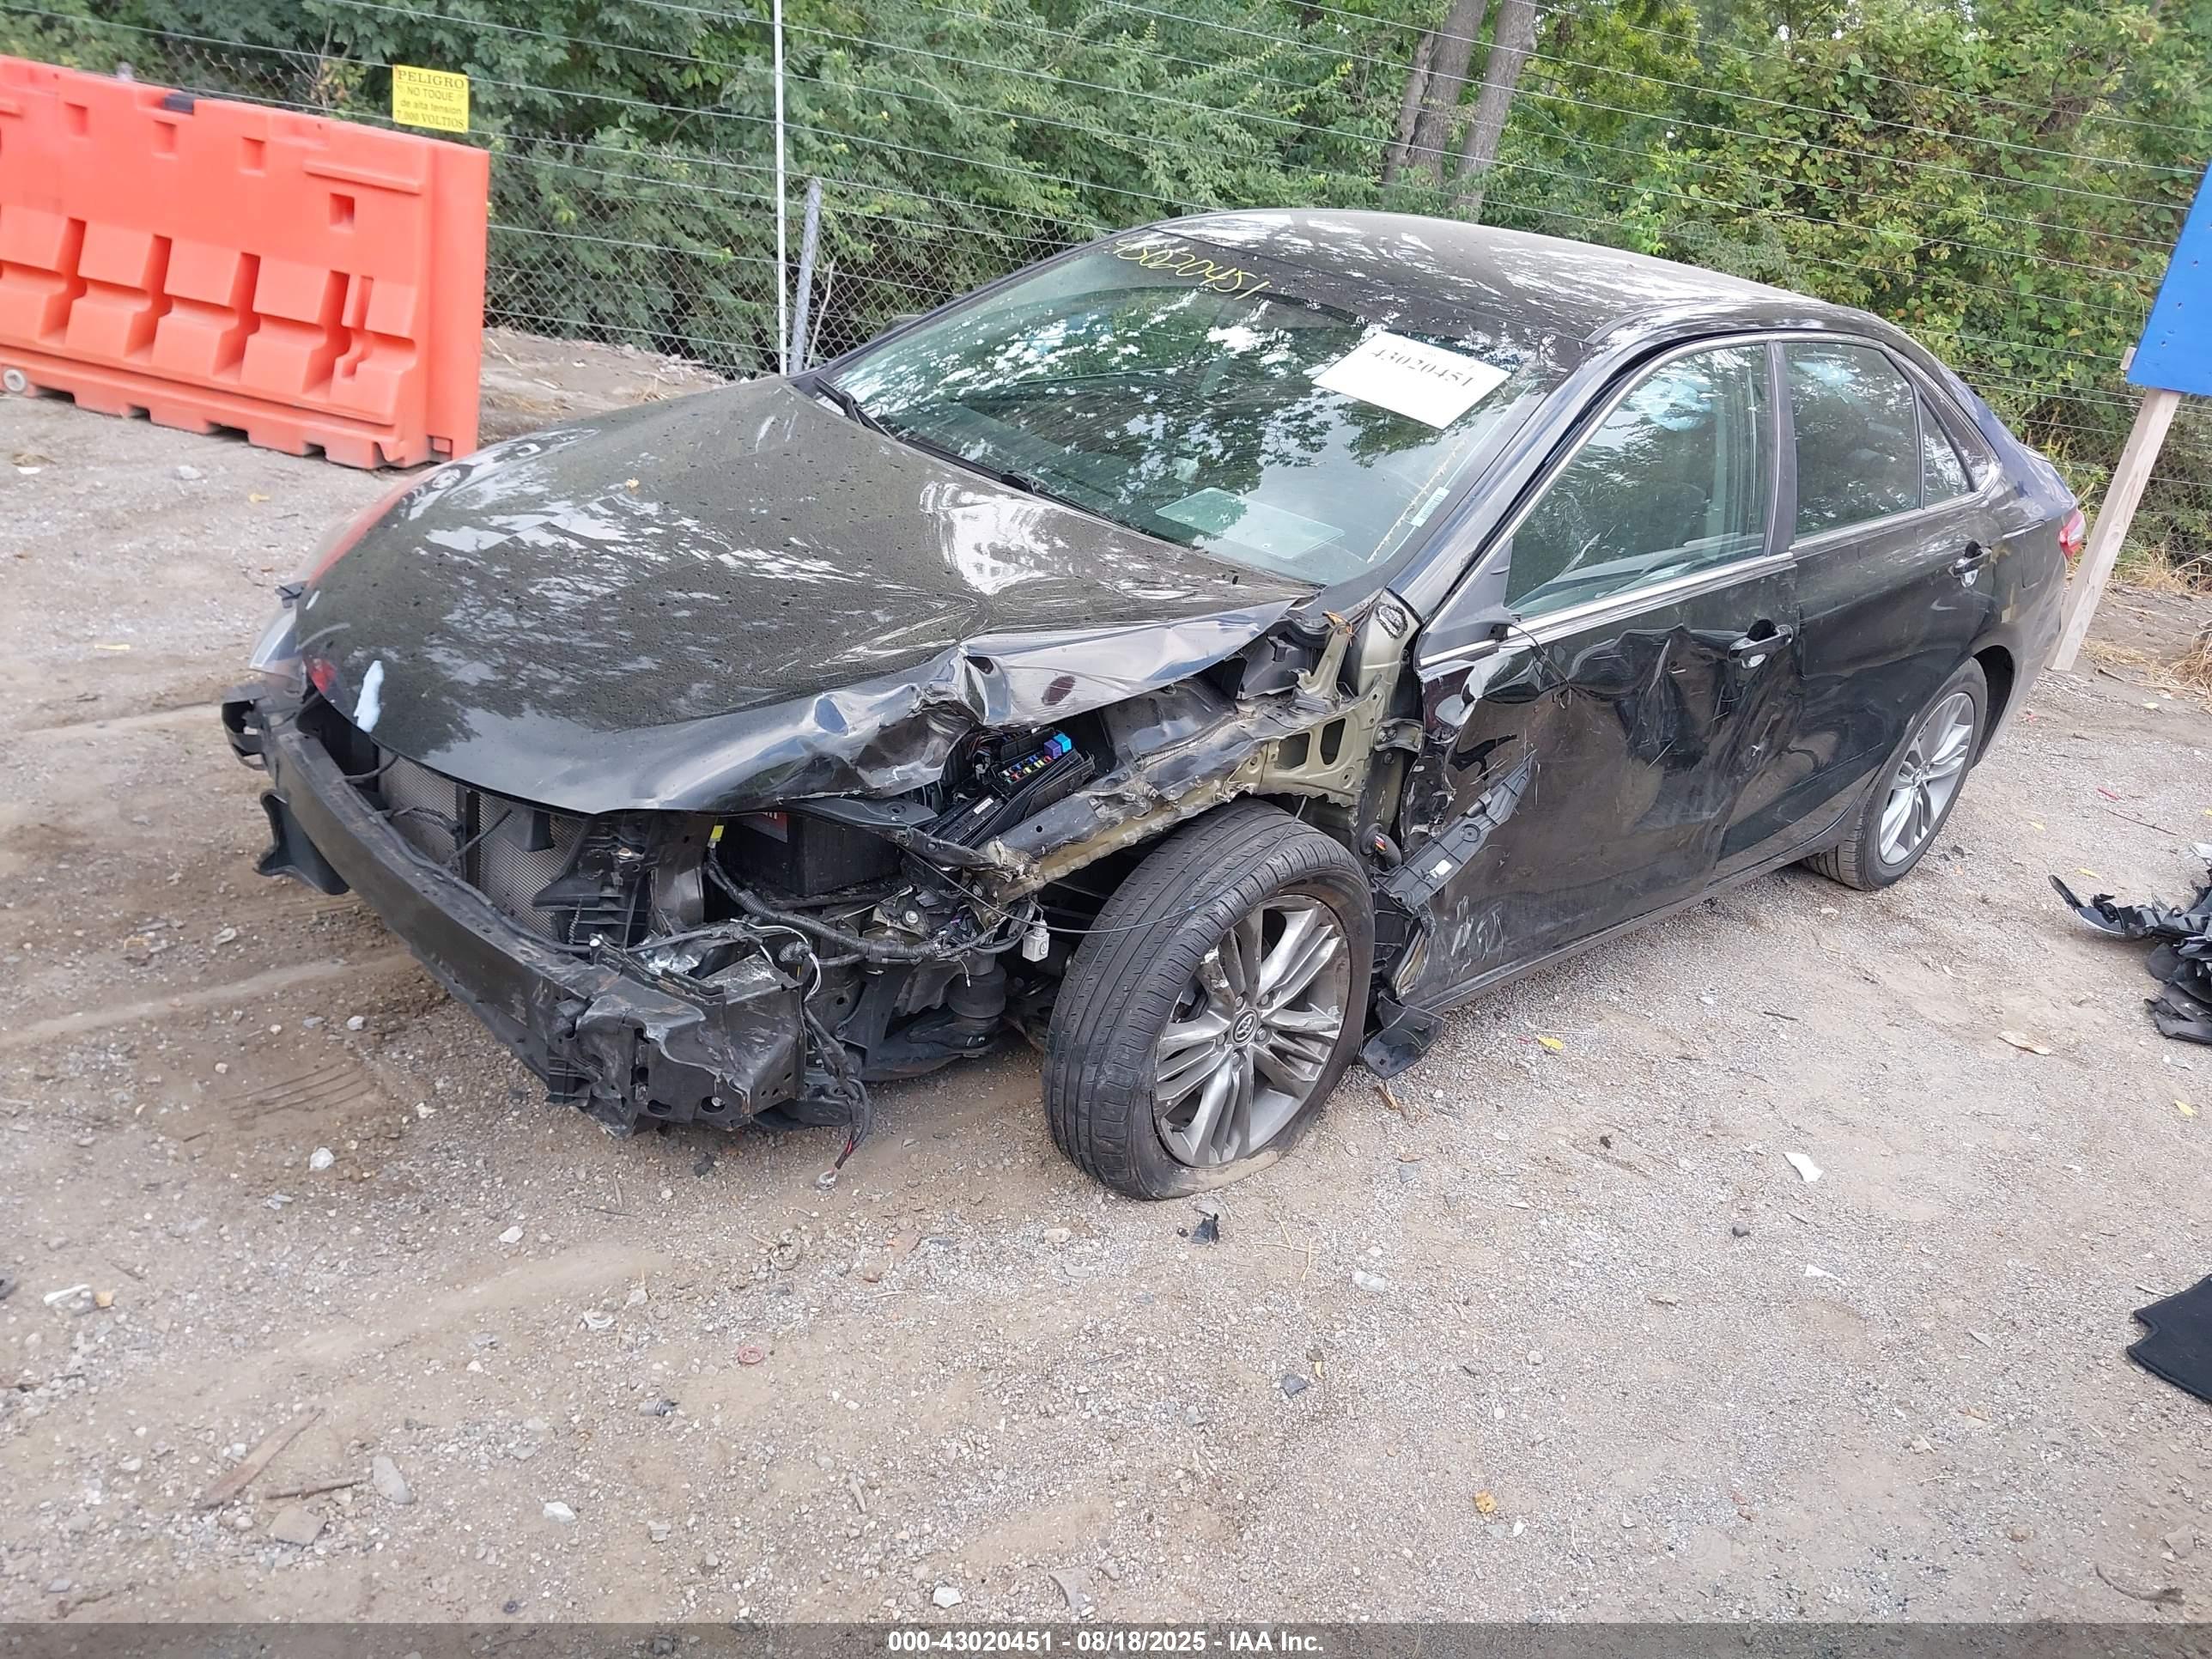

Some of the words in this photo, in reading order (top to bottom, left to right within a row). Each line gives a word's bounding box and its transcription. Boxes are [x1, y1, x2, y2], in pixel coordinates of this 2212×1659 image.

[398, 70, 465, 89] PELIGRO
[407, 86, 420, 96] NO
[422, 88, 454, 102] TOQUE
[421, 112, 465, 128] VOLTIOS
[1368, 349, 1474, 387] 43020451
